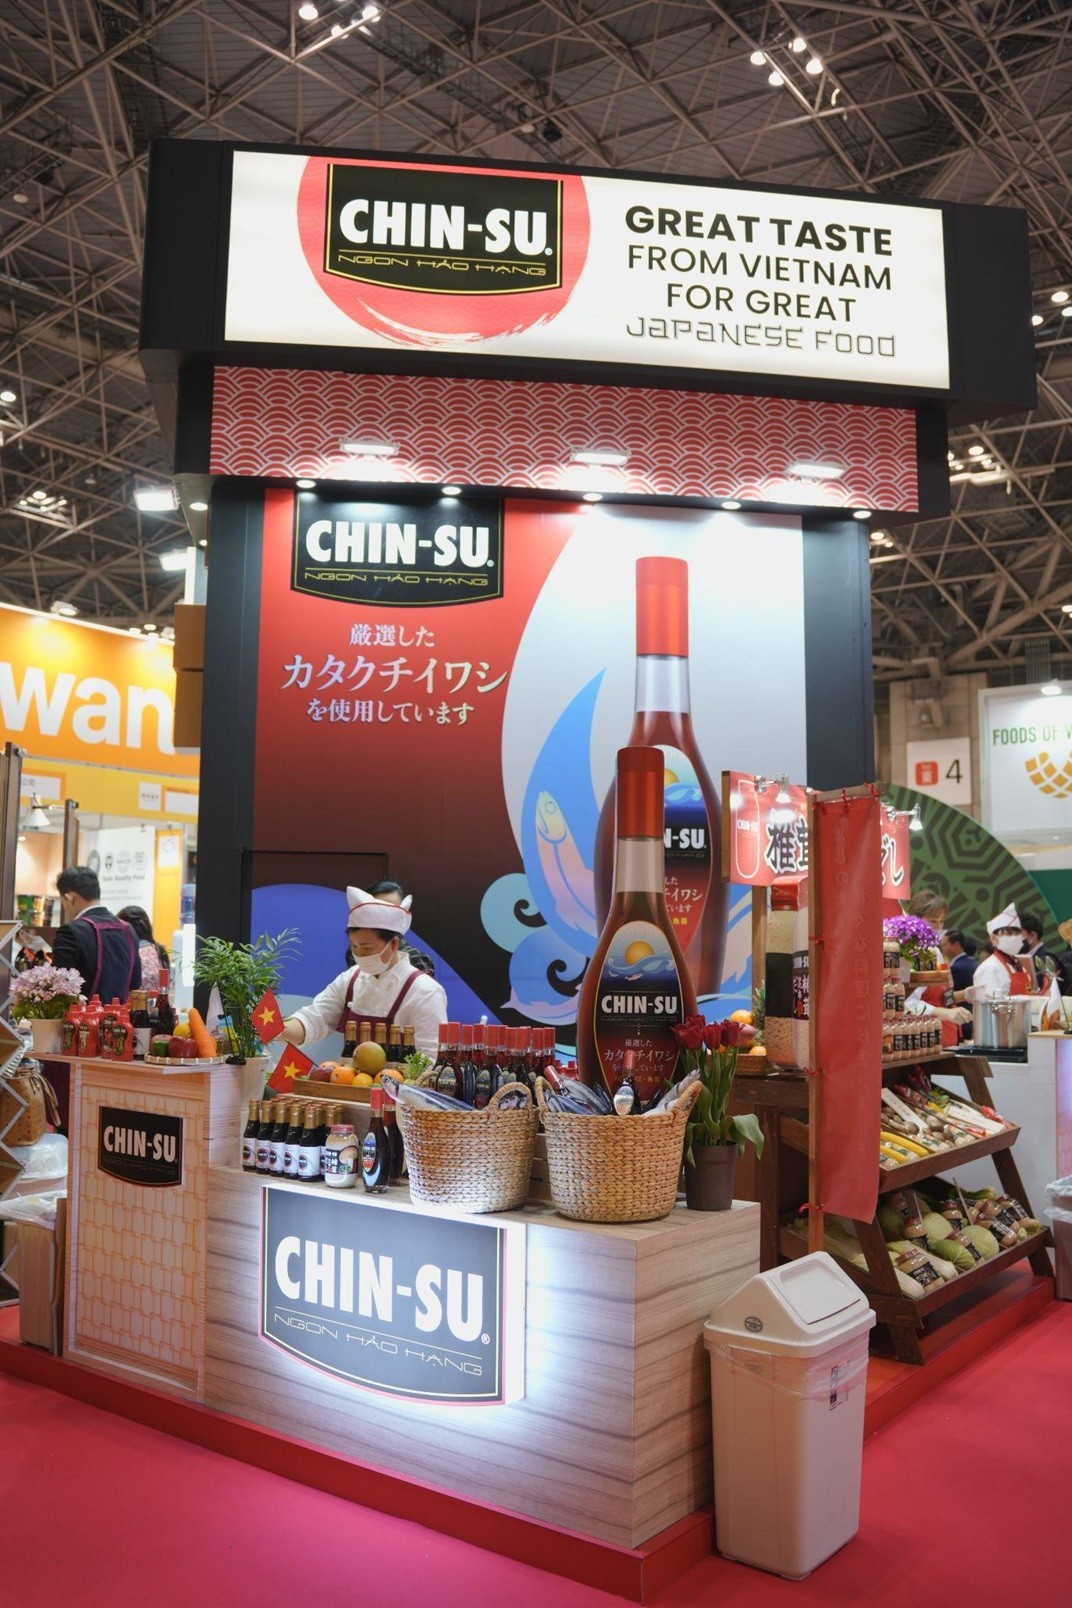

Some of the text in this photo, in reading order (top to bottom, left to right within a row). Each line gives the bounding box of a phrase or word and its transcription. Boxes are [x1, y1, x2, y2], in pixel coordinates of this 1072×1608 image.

[625, 205, 892, 256] GREAT TASTE
[338, 254, 409, 266] NGON
[628, 244, 891, 290] FROM VIETNAM
[667, 283, 856, 322] FOR GREAT
[304, 572, 367, 582] NGON
[349, 623, 436, 648] 厳選した
[280, 654, 508, 694] カタクチイワシ
[306, 698, 475, 726] を使用しています
[992, 726, 1037, 746] FOODS
[945, 759, 963, 784] 4
[604, 1049, 675, 1062] カタチイワシ
[274, 1313, 338, 1339] NGON
[404, 1348, 483, 1376] HẠNG
